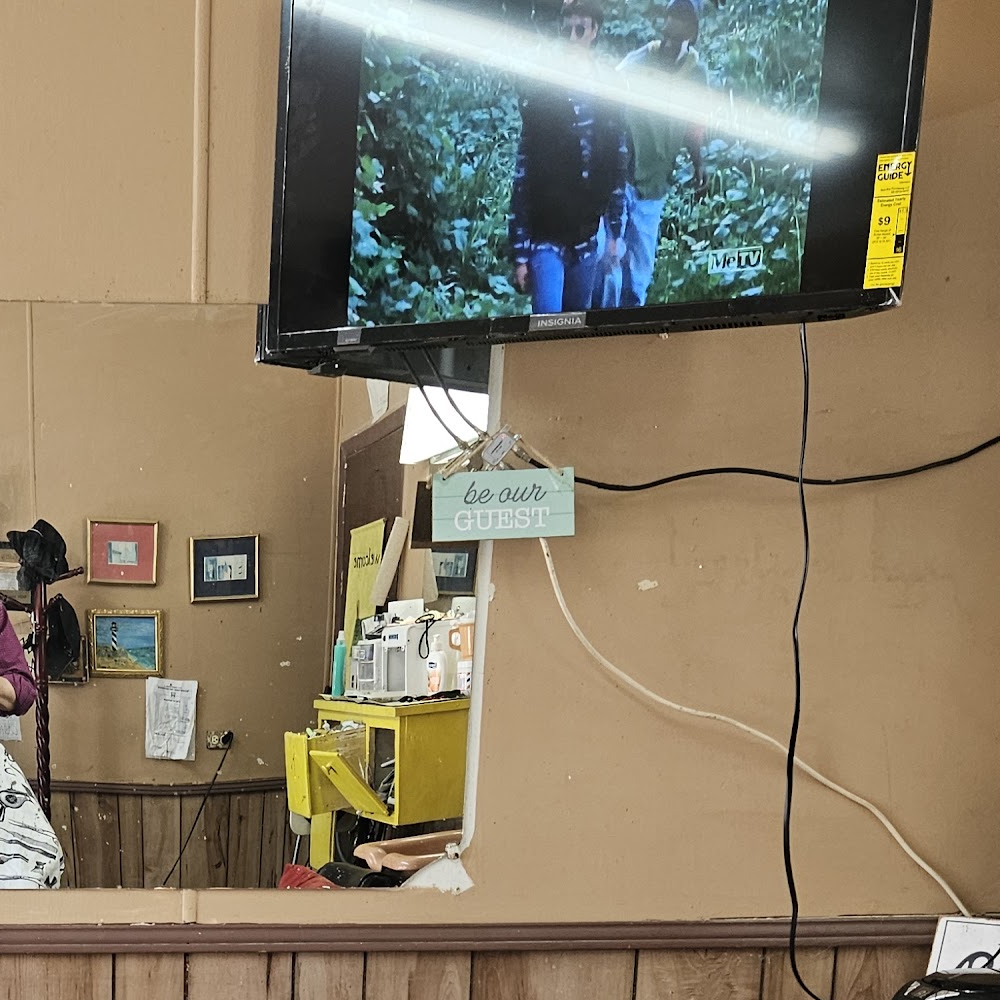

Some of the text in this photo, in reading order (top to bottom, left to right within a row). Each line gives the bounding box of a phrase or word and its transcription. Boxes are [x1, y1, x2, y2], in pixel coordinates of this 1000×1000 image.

[877, 171, 904, 181] GUIDE
[878, 216, 891, 226] $9
[710, 250, 762, 272] MeTV
[537, 316, 582, 328] INSIGNIA
[463, 481, 548, 505] be our
[454, 506, 550, 531] GUEST
